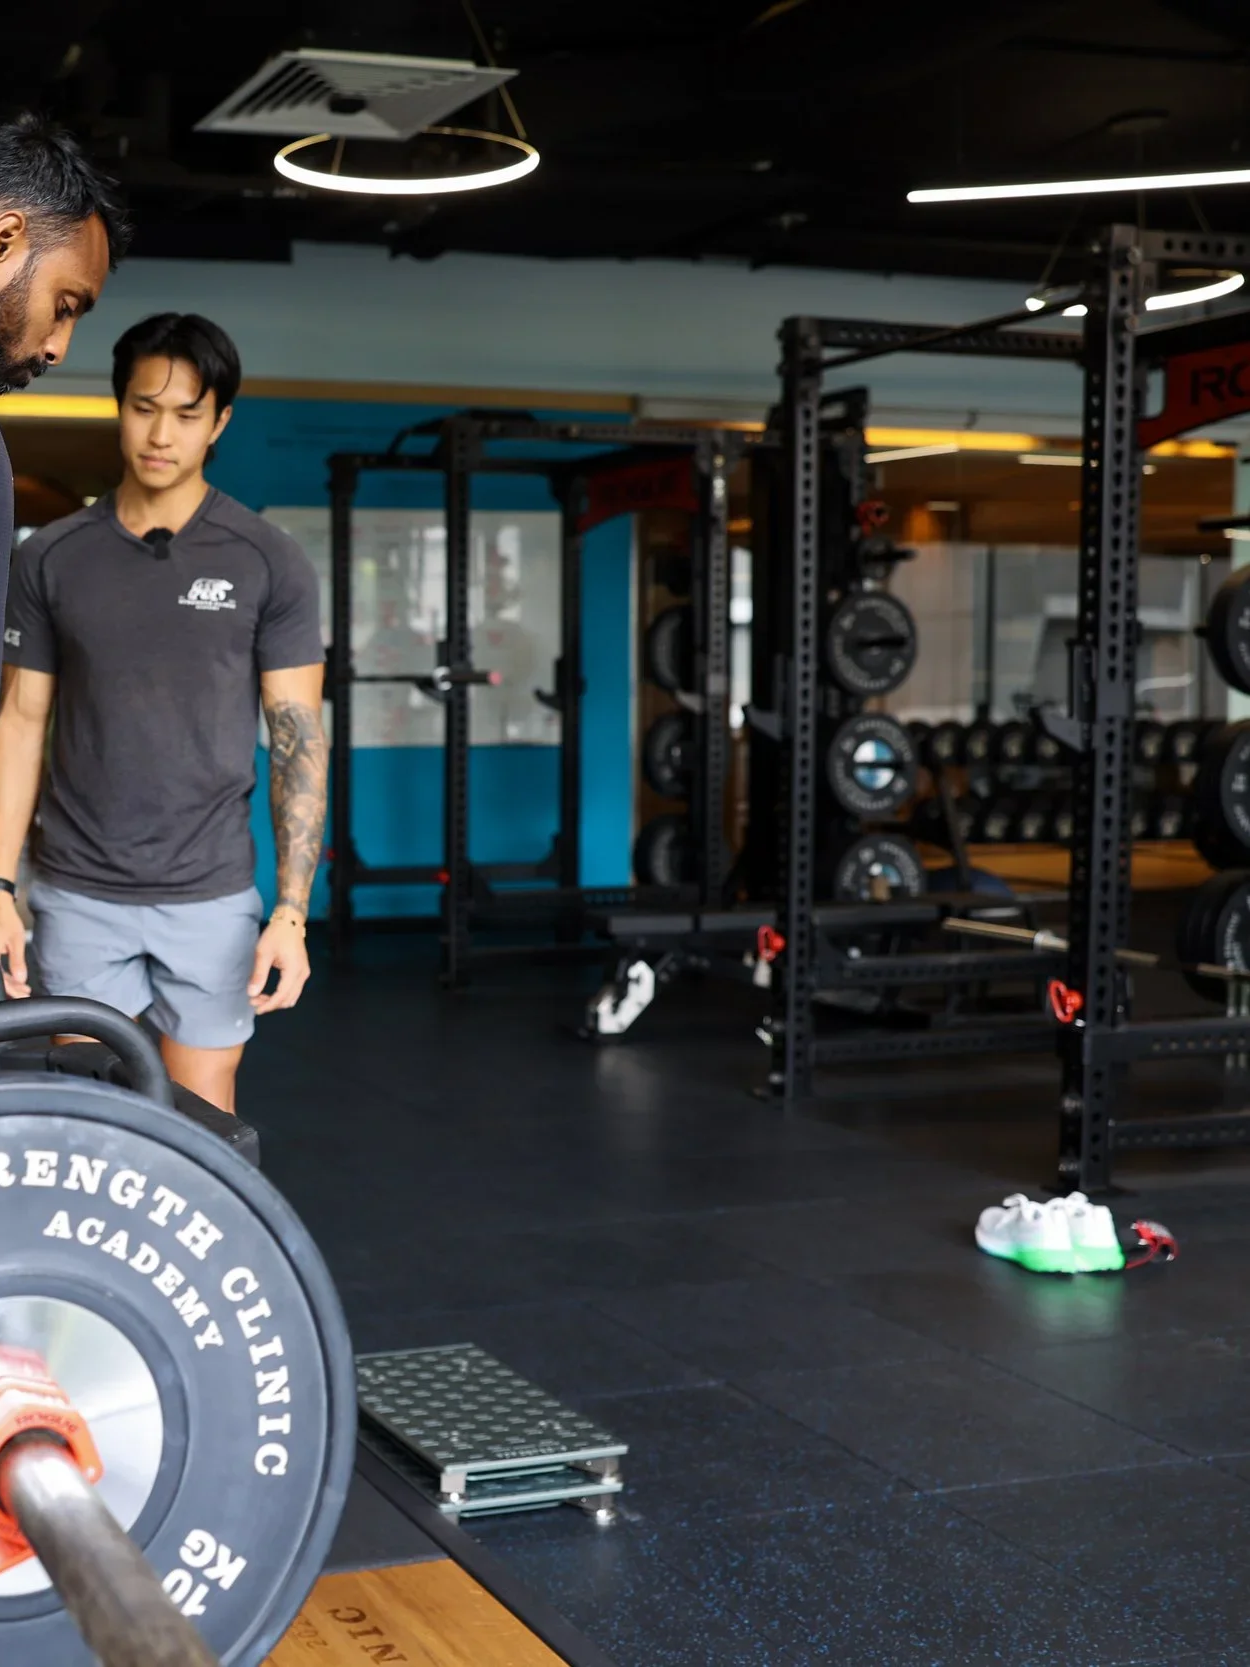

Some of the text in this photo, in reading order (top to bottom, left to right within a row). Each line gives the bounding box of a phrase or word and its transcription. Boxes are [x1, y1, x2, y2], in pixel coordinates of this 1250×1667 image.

[43, 1210, 224, 1350] ACADEMY
[220, 1266, 291, 1477] CLINIC
[161, 1568, 210, 1617] 10
[178, 1528, 247, 1591] KG
